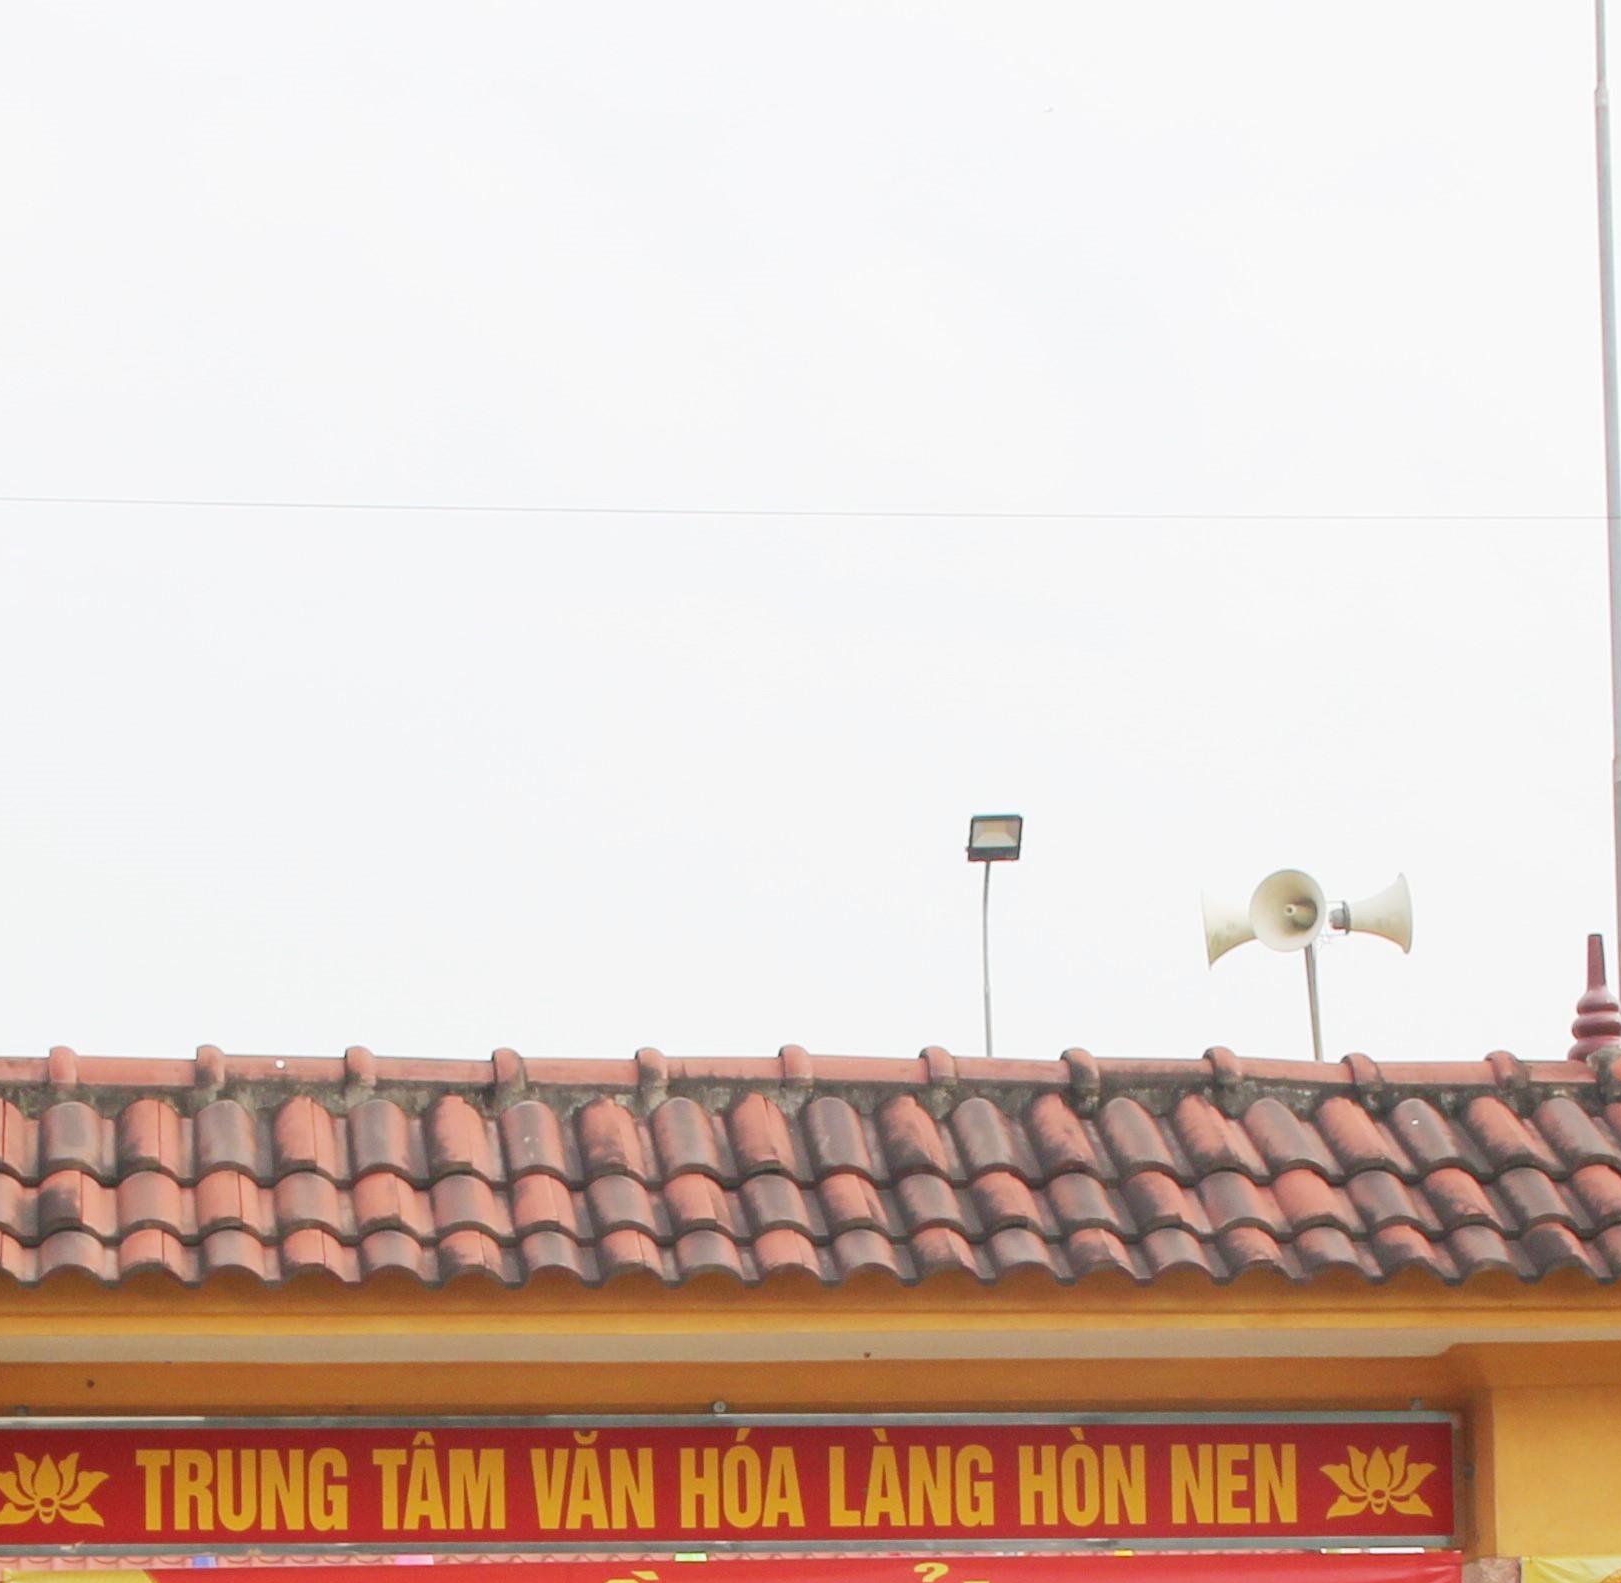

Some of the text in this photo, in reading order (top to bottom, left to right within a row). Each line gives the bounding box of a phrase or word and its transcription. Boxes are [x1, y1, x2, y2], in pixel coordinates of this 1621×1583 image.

[136, 1427, 1298, 1532] TRUNG TÂM VĂN HÓA LÀNG HÒN NEN
